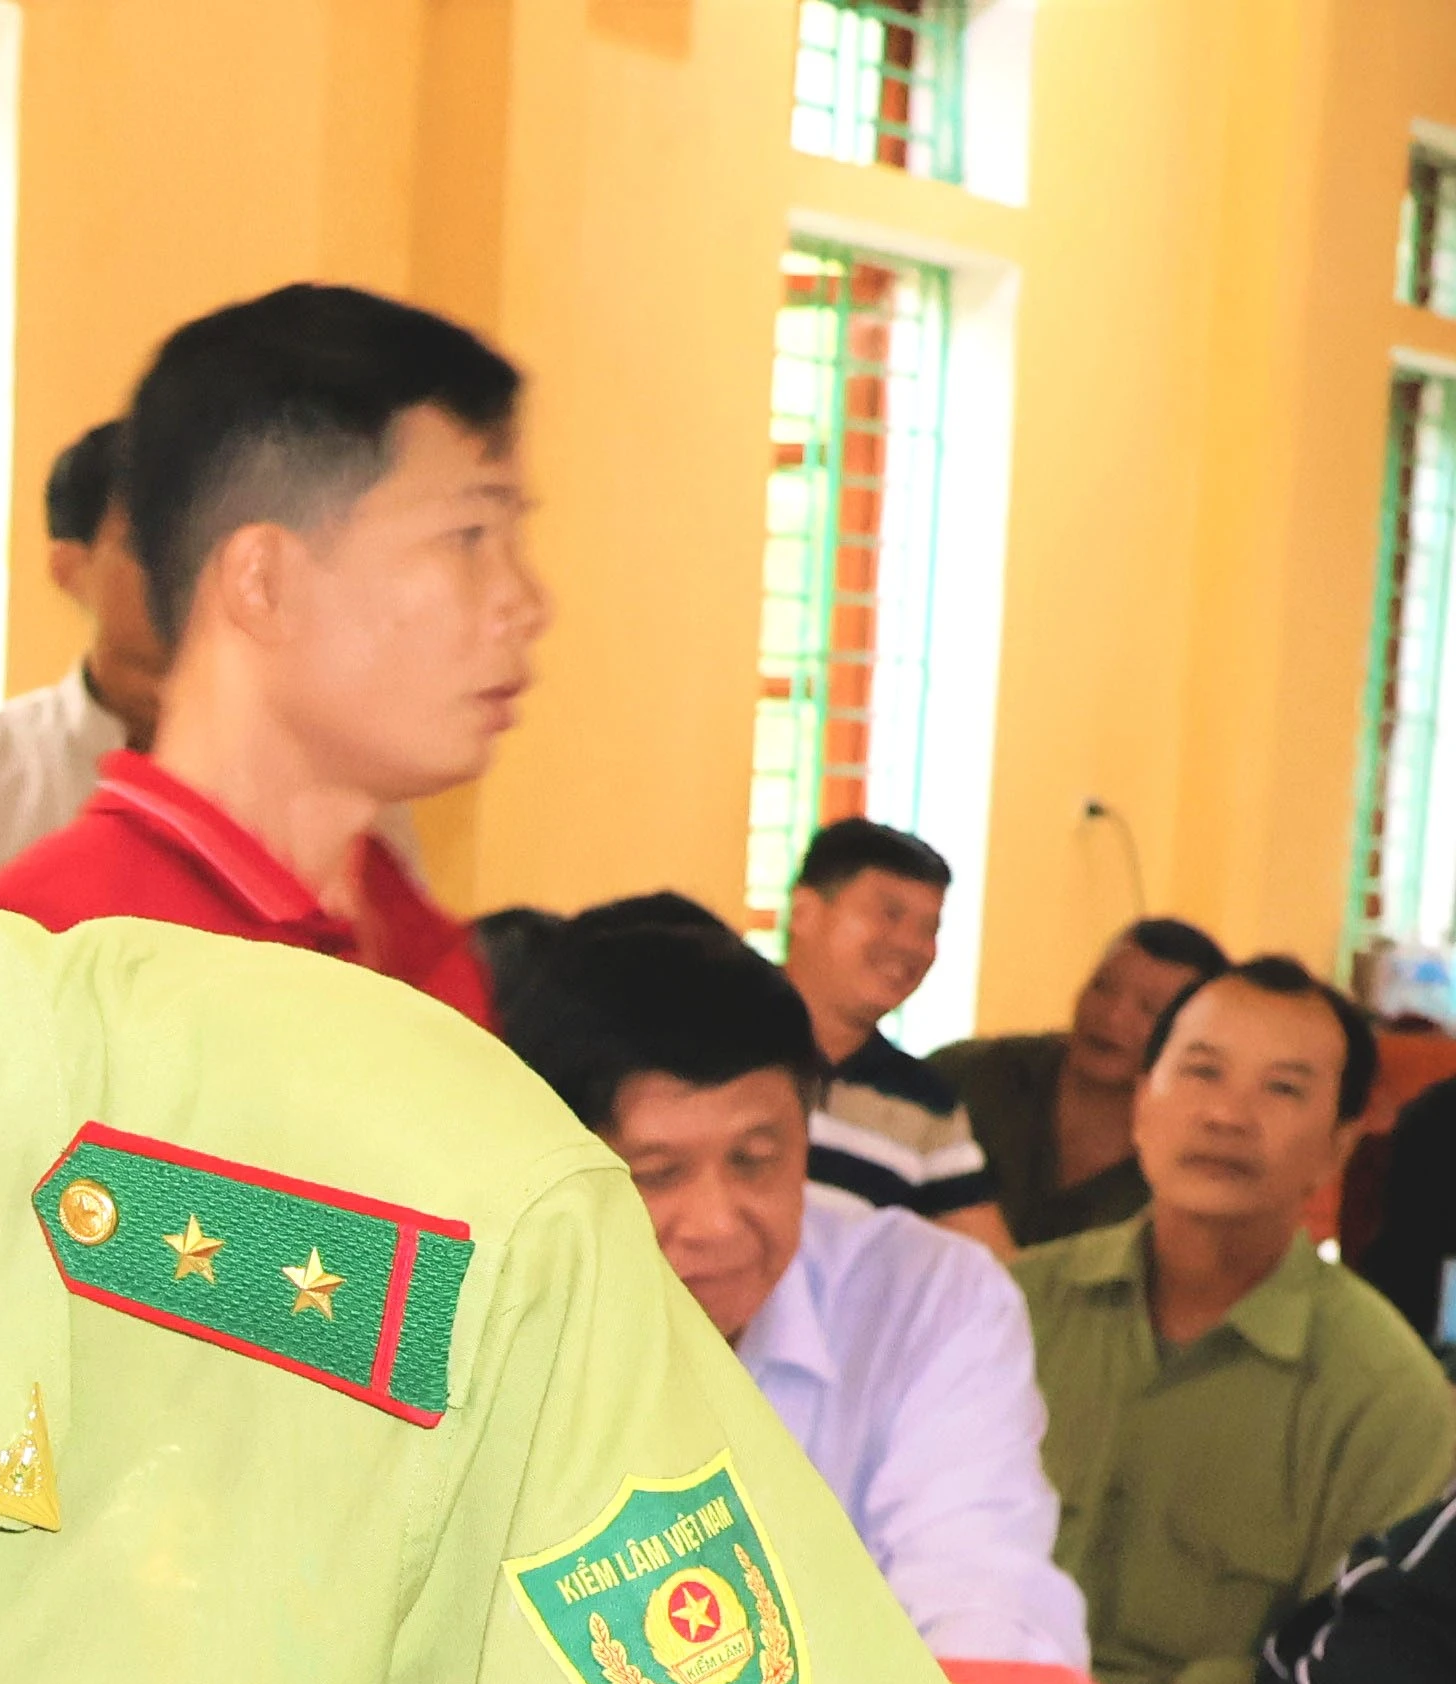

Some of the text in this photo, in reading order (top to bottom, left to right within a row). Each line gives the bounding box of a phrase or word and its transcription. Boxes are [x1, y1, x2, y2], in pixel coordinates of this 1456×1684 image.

[555, 1495, 734, 1605] KIỂM LÂM VIỆT NAM
[718, 1641, 745, 1664] LÂM
